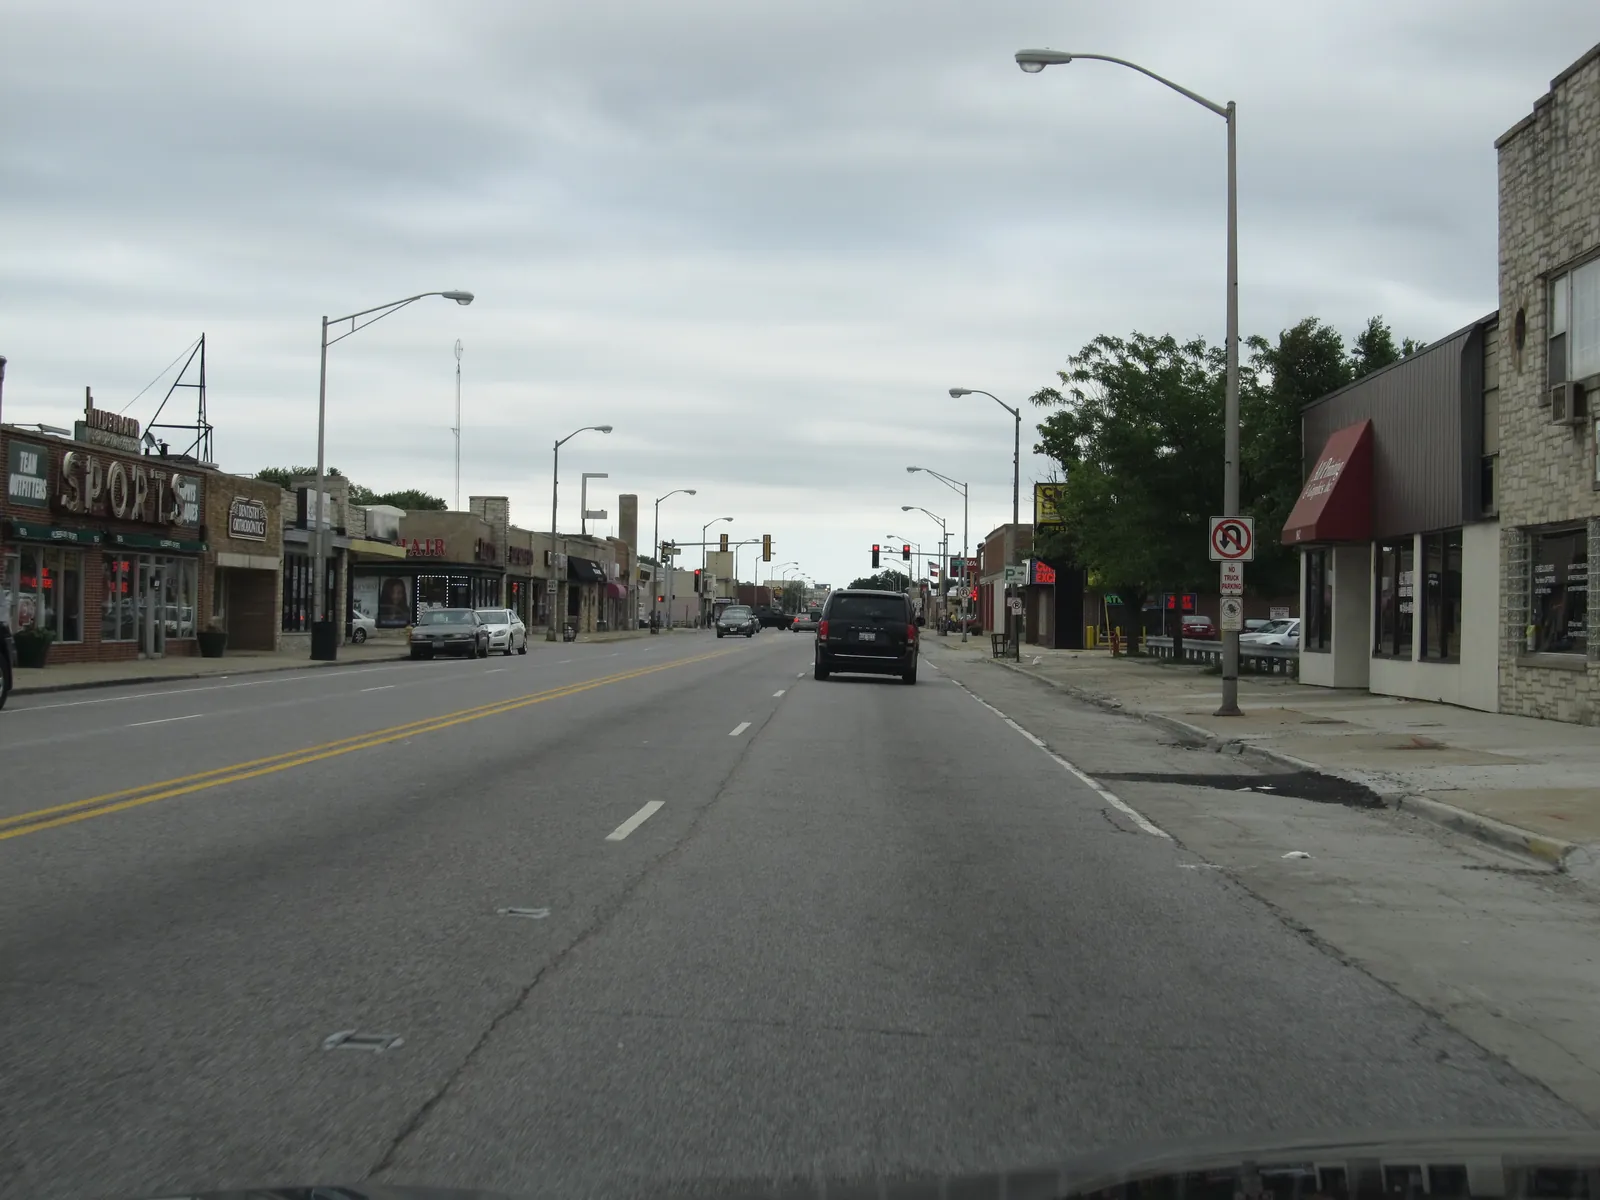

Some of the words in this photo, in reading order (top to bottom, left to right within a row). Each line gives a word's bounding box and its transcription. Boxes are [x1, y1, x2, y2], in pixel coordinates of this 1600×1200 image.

[86, 407, 140, 439] HILDEBRAND
[20, 451, 38, 475] TEAM
[9, 473, 48, 500] OUTFITTERS
[61, 451, 187, 526] SPORTS
[238, 504, 261, 520] DENTISTRY
[232, 518, 265, 535] ORTHODONTICS
[1005, 568, 1016, 581] P
[1223, 574, 1240, 582] TRUCK
